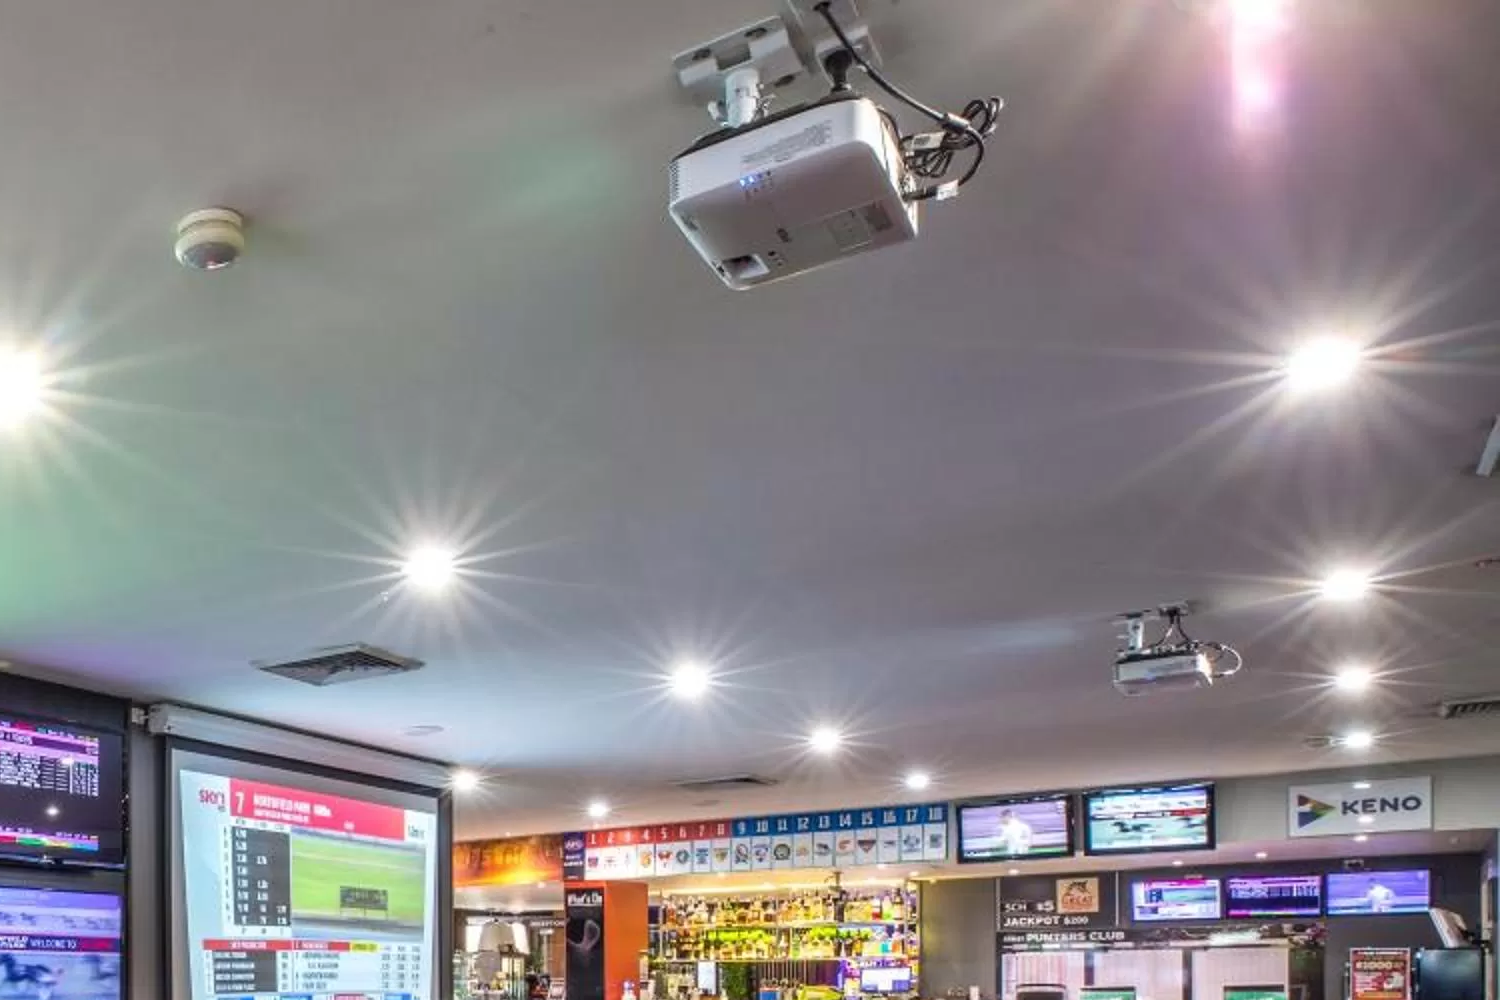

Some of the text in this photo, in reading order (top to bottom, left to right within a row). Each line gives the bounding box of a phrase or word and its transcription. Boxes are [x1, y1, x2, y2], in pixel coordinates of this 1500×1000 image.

[235, 792, 244, 814] 7
[1341, 795, 1422, 815] KENO
[756, 819, 769, 833] 10
[777, 818, 788, 832] 11
[797, 816, 810, 830] 12
[818, 815, 830, 829] 13
[839, 813, 852, 827] 14
[861, 811, 873, 825] 15
[906, 808, 919, 822] 17
[1003, 916, 1060, 927] JACKPOT
[1090, 931, 1125, 941] CLUB
